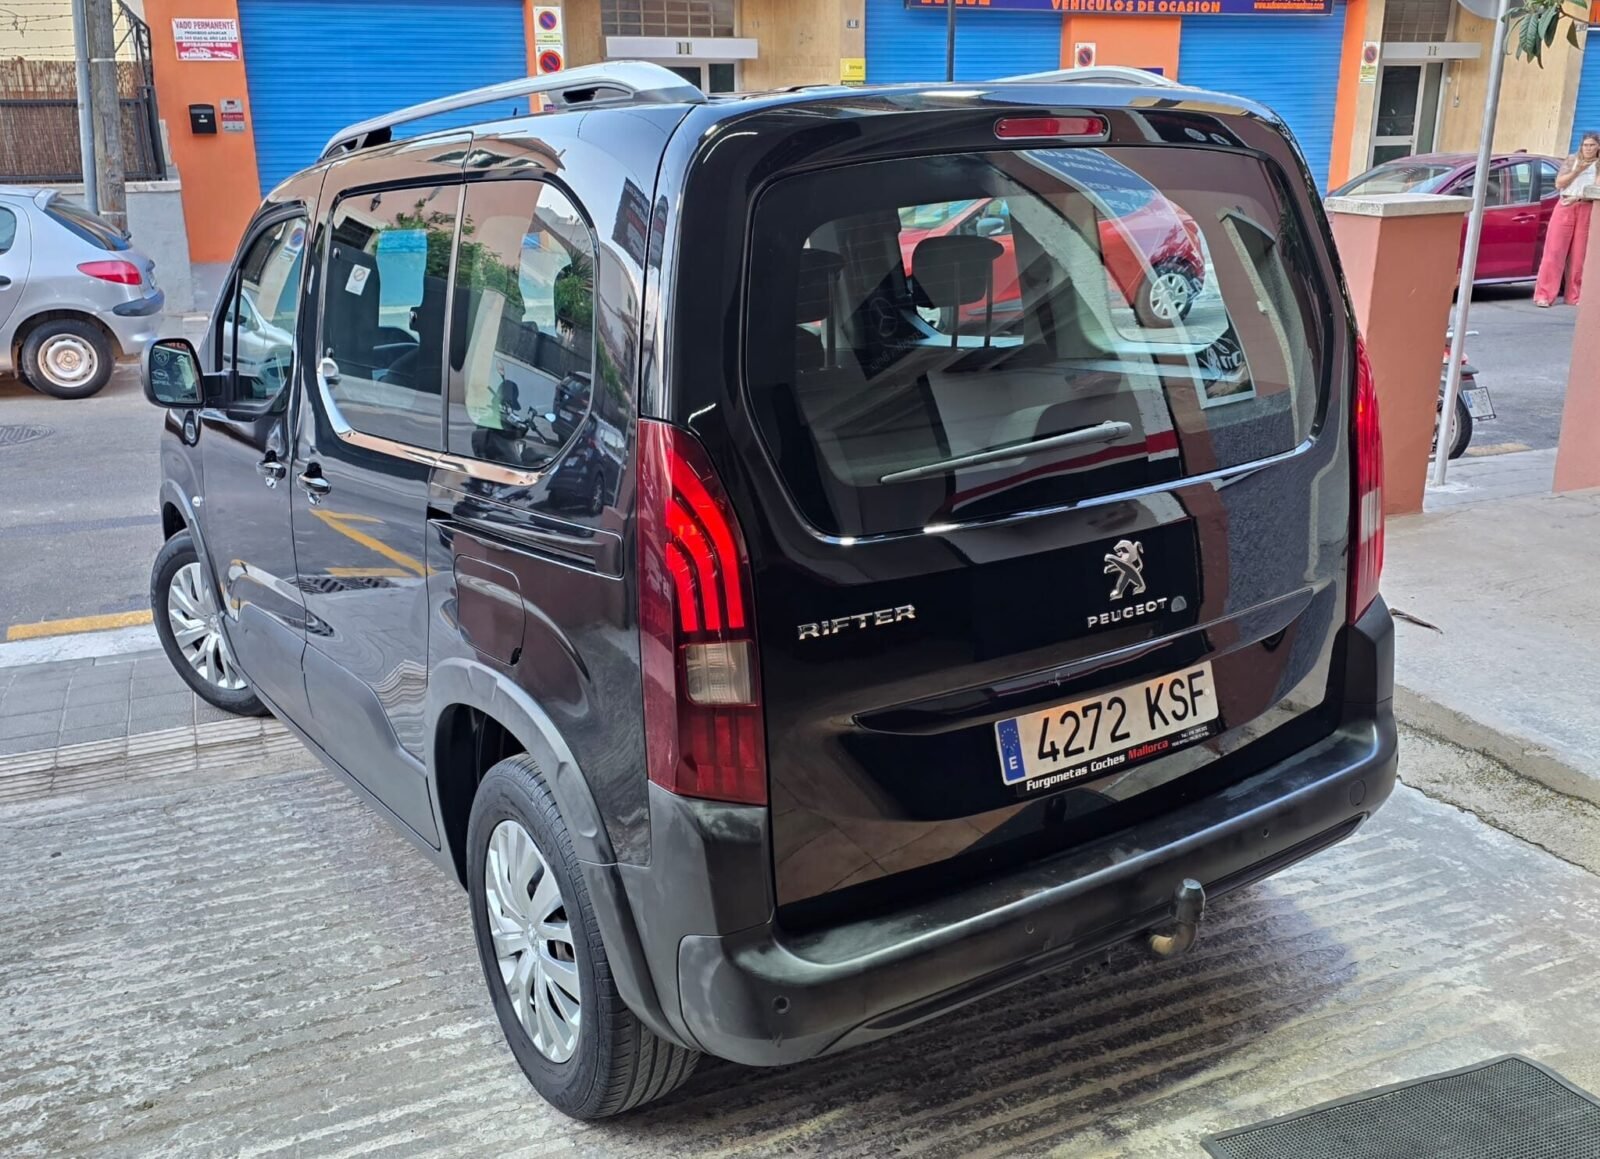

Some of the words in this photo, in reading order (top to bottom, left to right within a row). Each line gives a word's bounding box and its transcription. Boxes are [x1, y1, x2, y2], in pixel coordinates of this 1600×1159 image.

[1137, 1, 1155, 12] DE
[1158, 1, 1221, 13] OCASION
[175, 20, 192, 29] VADO
[193, 20, 234, 30] PERMANENTE
[797, 604, 916, 640] RIFTER
[1086, 597, 1168, 628] PEUGEOT
[1037, 696, 1130, 762] 4272
[1145, 670, 1205, 730] KSF
[1009, 756, 1018, 770] E
[1026, 766, 1088, 791] Furgonetas
[1090, 754, 1125, 772] Coches
[1127, 739, 1169, 760] Mallorca
